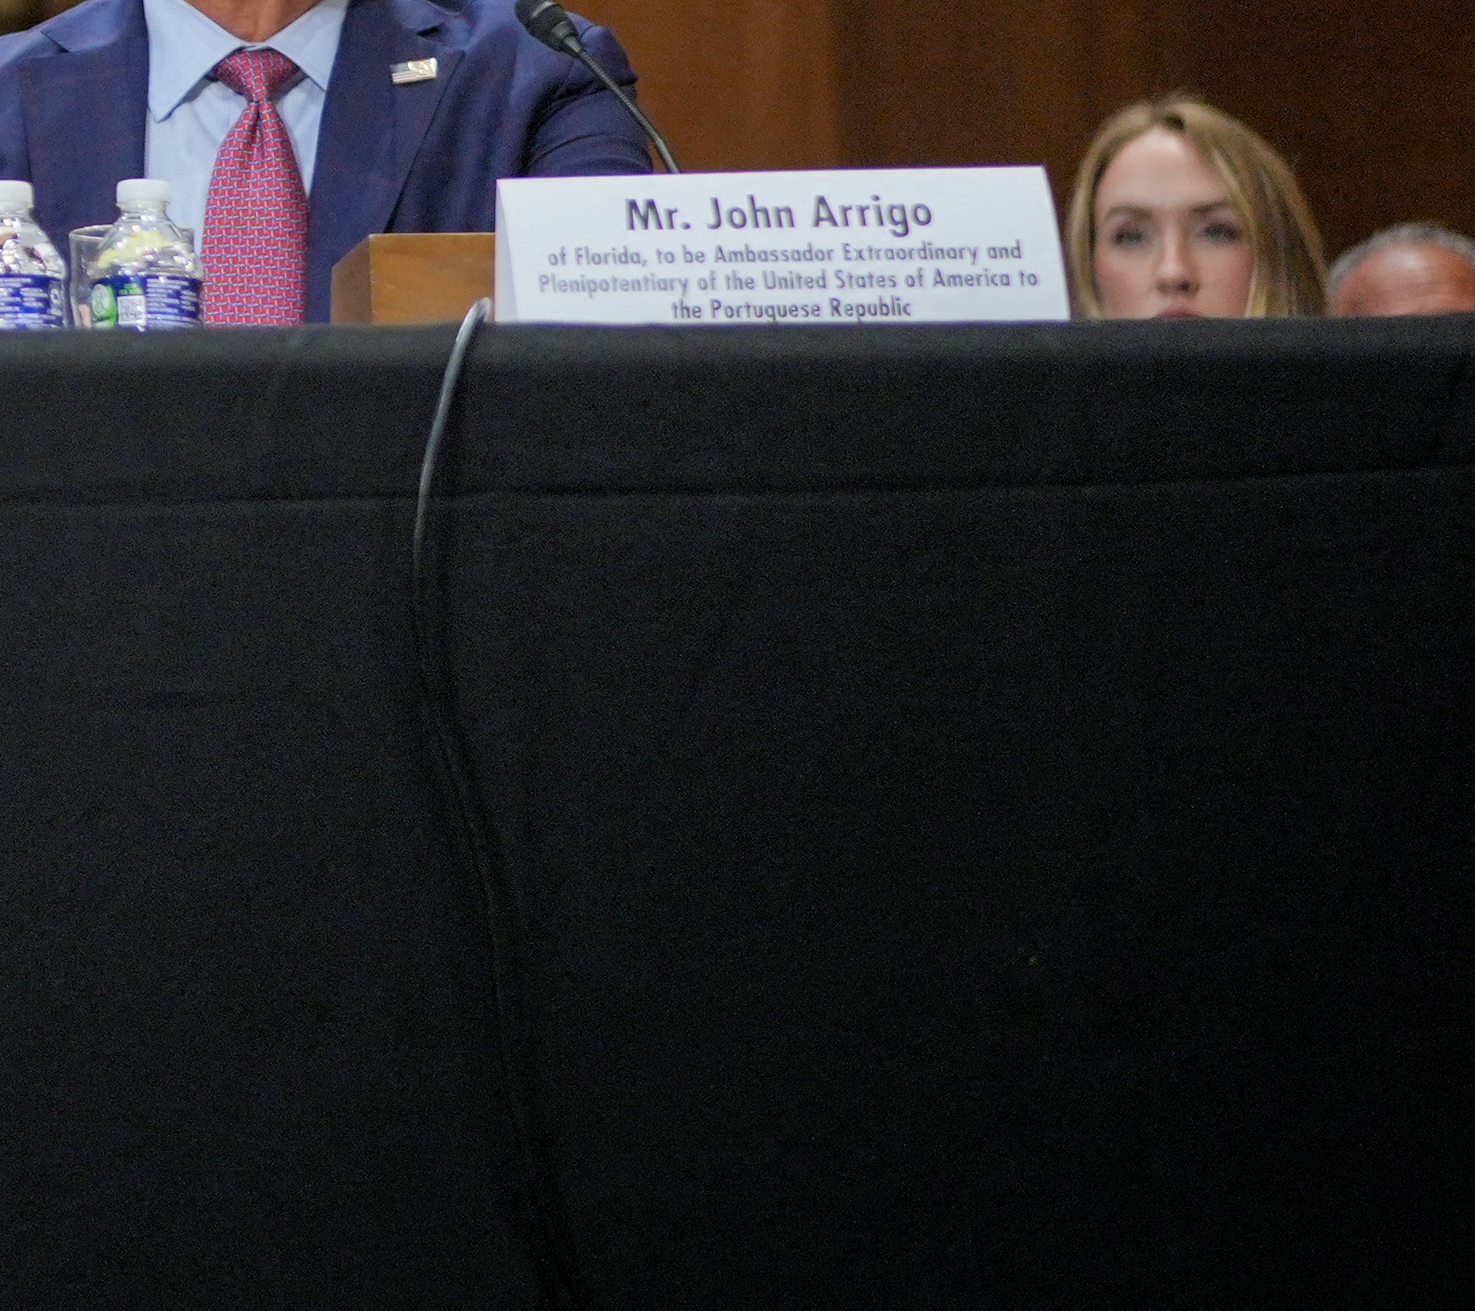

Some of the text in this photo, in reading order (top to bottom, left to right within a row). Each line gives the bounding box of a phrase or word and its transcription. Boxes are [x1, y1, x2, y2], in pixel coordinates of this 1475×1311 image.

[625, 194, 932, 238] Mr. John Arrigo
[547, 240, 1022, 268] of Florida, to be Ambassador Extraordinary and
[538, 267, 1038, 298] Plenipotentiary of the United States of America to
[671, 295, 912, 322] the Portuguese Republic
